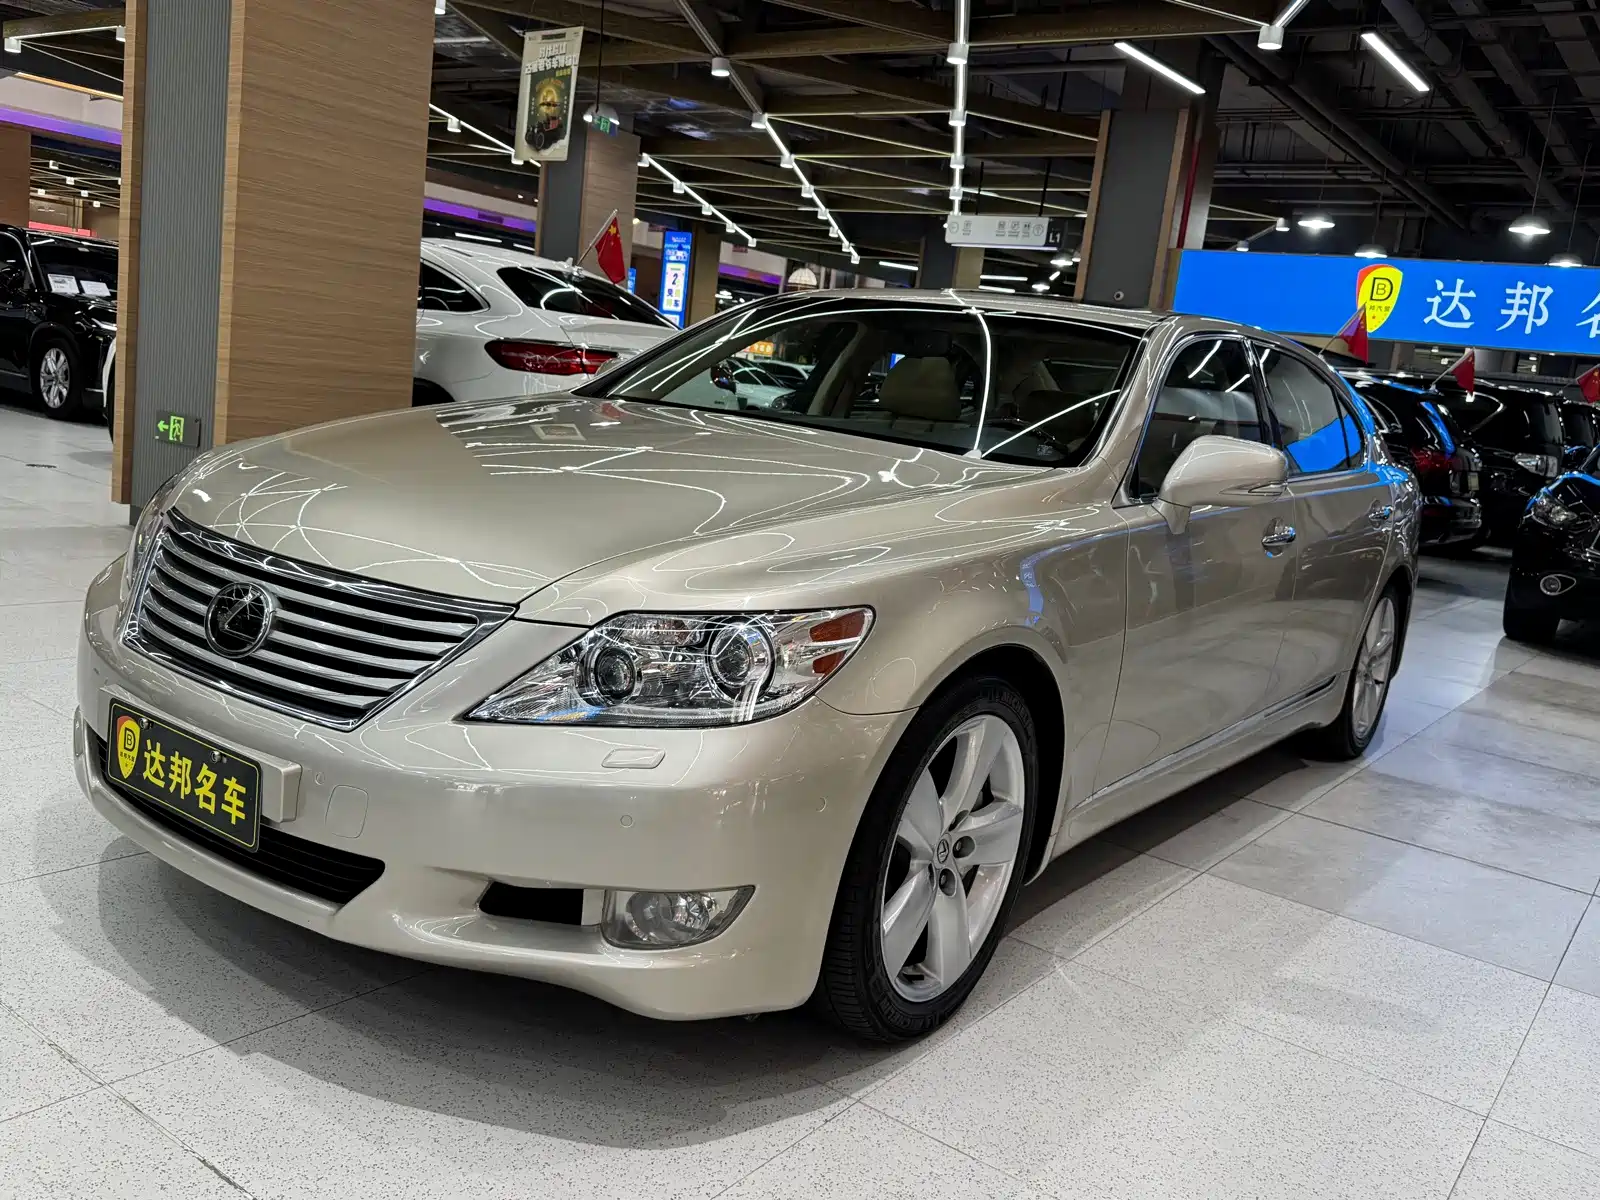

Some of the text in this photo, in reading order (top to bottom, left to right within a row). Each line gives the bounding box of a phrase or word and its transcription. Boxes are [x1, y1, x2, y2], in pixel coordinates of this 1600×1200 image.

[1049, 232, 1061, 243] L1
[142, 739, 247, 826] 达邦名车
